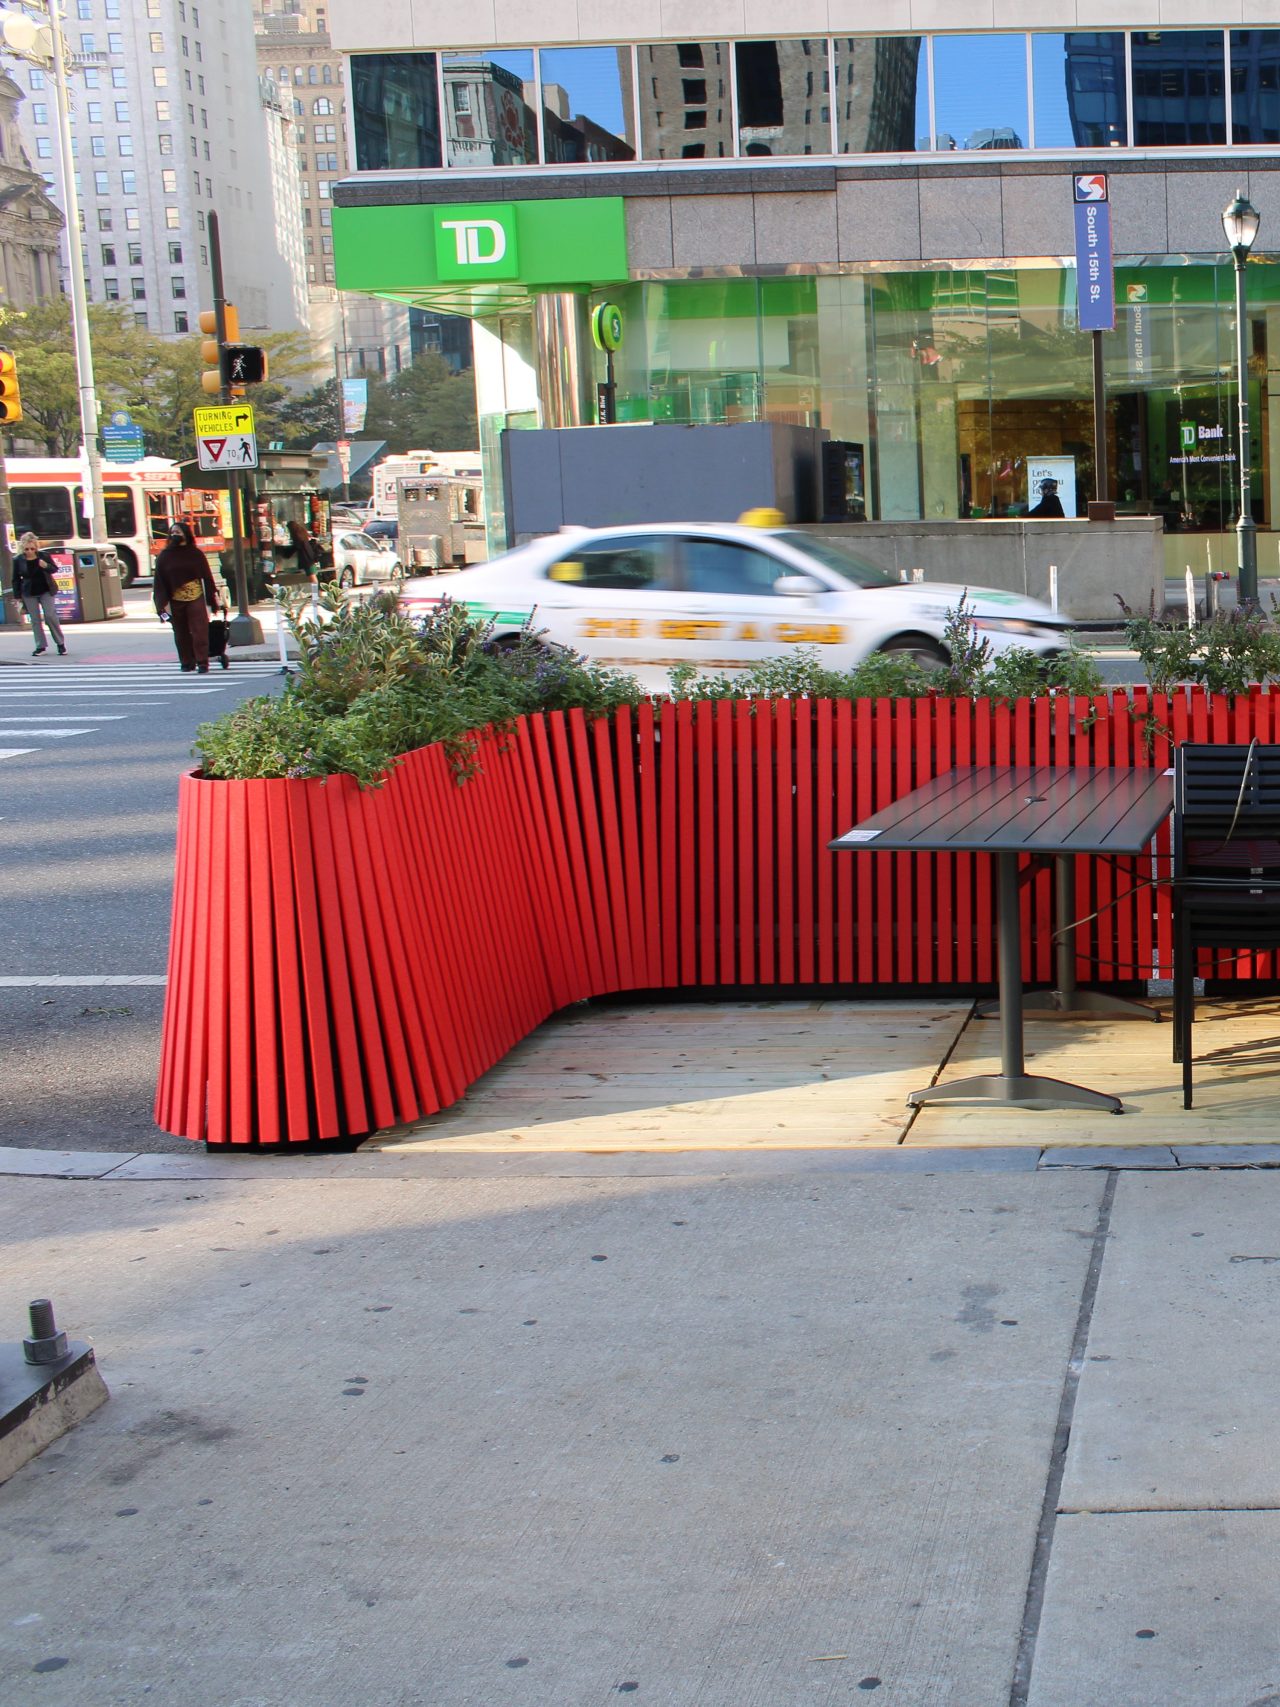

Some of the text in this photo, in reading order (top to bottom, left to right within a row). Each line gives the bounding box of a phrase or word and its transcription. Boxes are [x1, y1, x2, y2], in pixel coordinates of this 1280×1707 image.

[441, 219, 506, 265] TD
[1086, 206, 1101, 304] South 15th St.
[198, 411, 232, 422] TURNING
[199, 422, 234, 433] VEHICLES
[1181, 424, 1223, 445] TD Bank
[227, 449, 237, 458] TO
[143, 472, 178, 480] SEPTA
[1032, 469, 1053, 478] Let's
